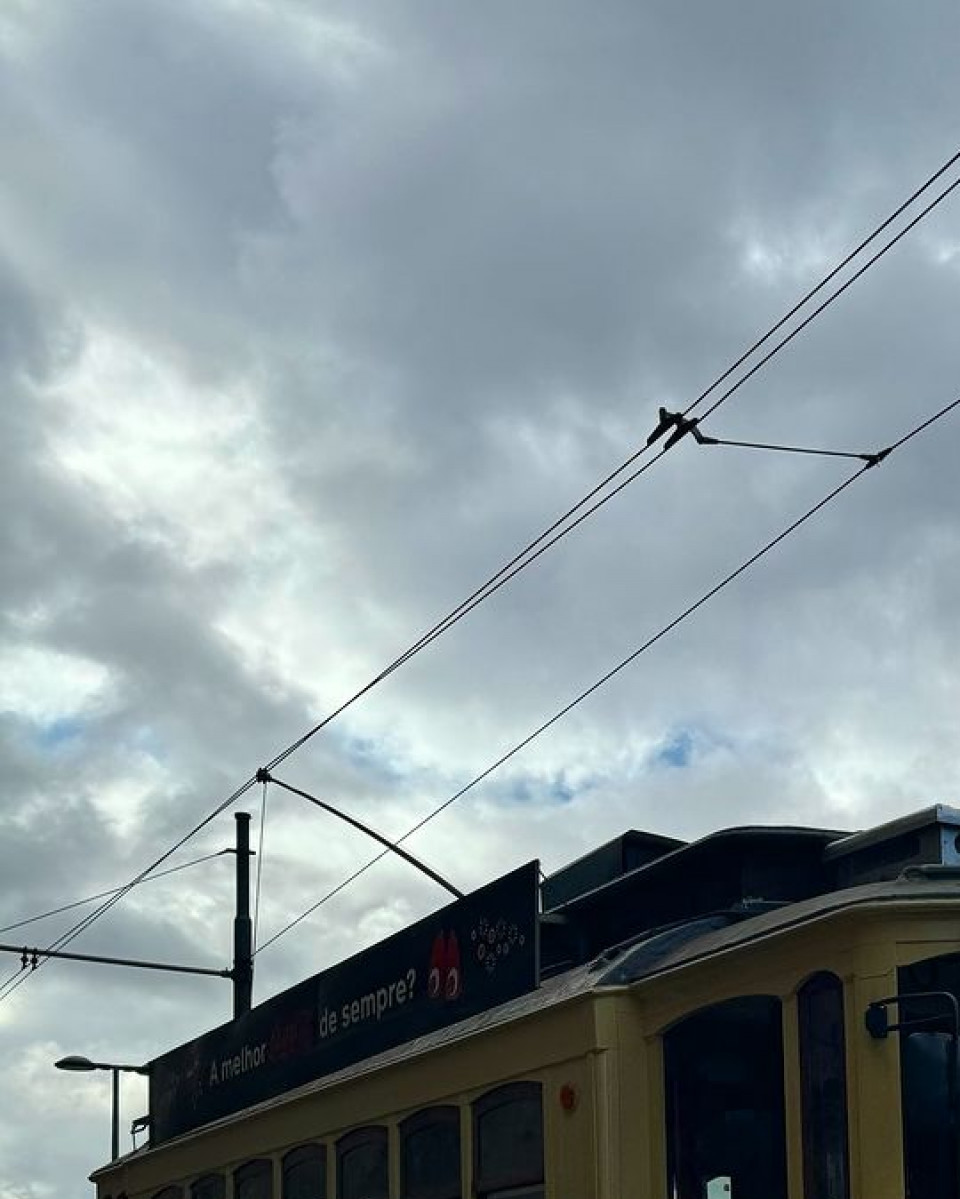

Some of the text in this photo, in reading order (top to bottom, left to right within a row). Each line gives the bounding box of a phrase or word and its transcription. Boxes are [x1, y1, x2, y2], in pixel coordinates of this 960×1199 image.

[221, 1042, 267, 1081] melhor
[319, 1007, 337, 1038] de
[342, 968, 417, 1028] sempre?
